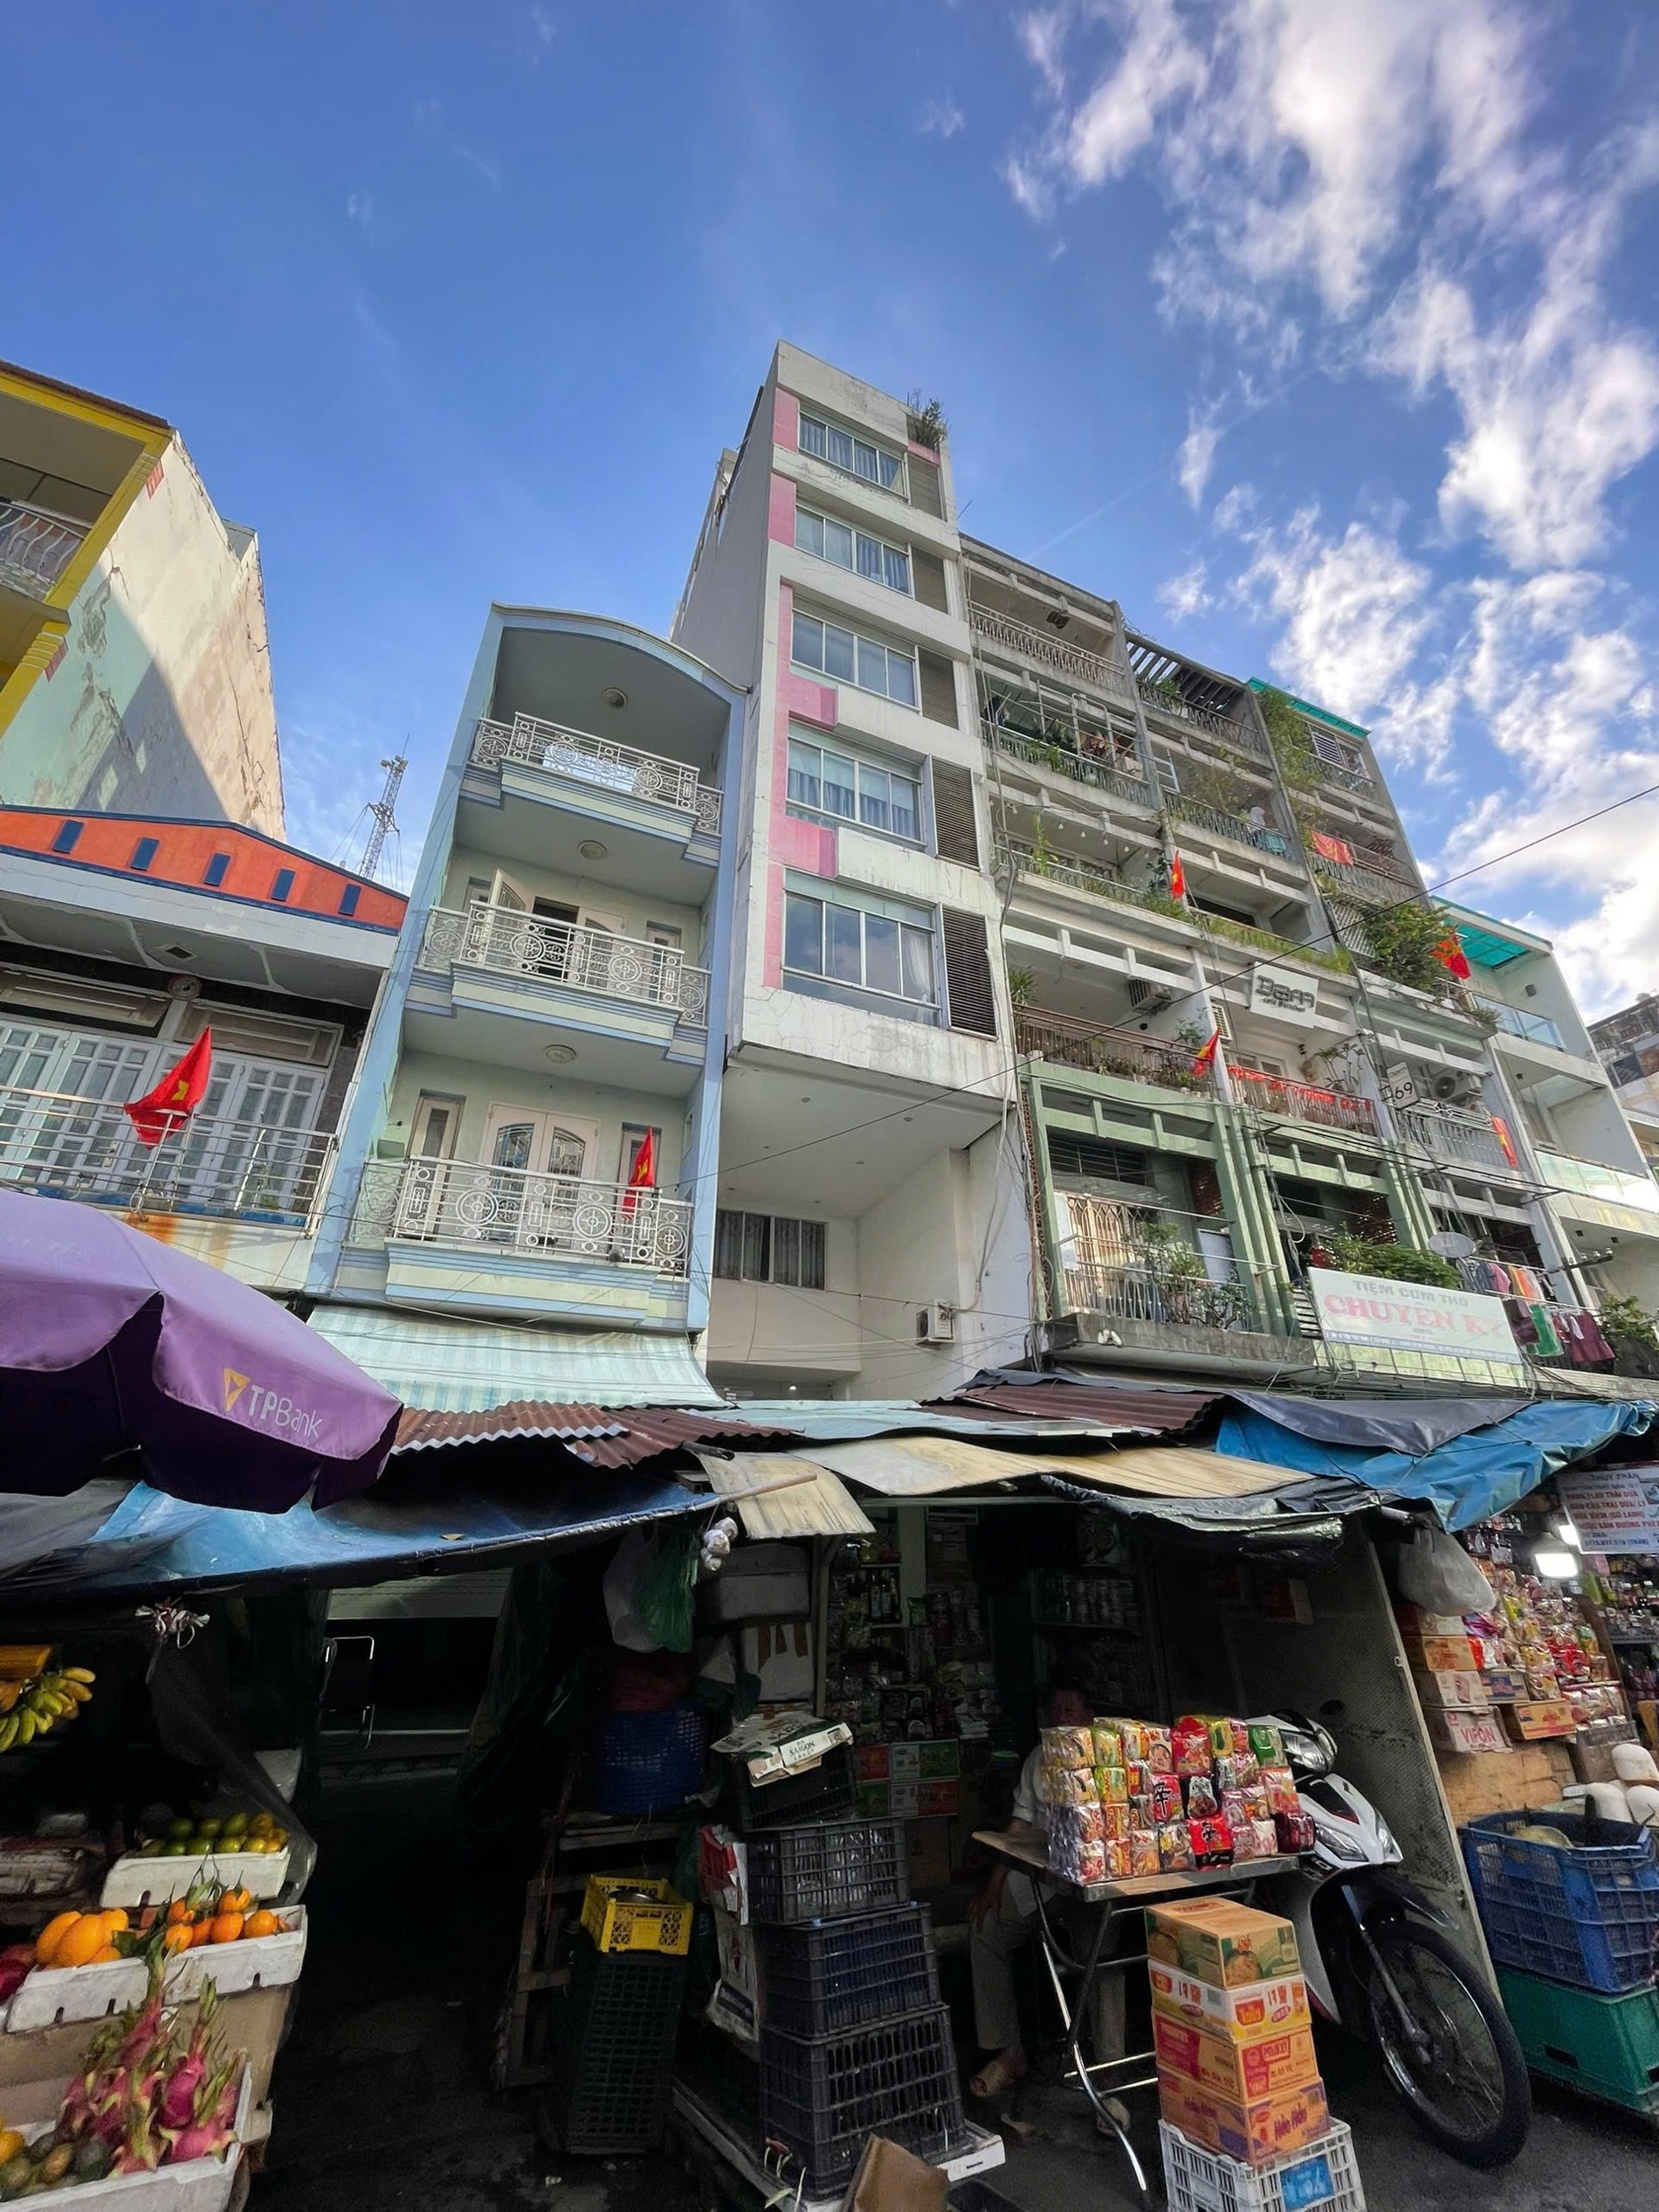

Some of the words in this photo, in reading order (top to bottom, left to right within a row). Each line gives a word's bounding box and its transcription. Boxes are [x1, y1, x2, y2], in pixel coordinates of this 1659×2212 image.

[1394, 1081, 1413, 1099] 69
[1353, 1279, 1394, 1297] TIỆM
[1323, 1293, 1455, 1331] CHUYÊN
[248, 1384, 323, 1439] TPBank
[1460, 1727, 1497, 1745] VIFON
